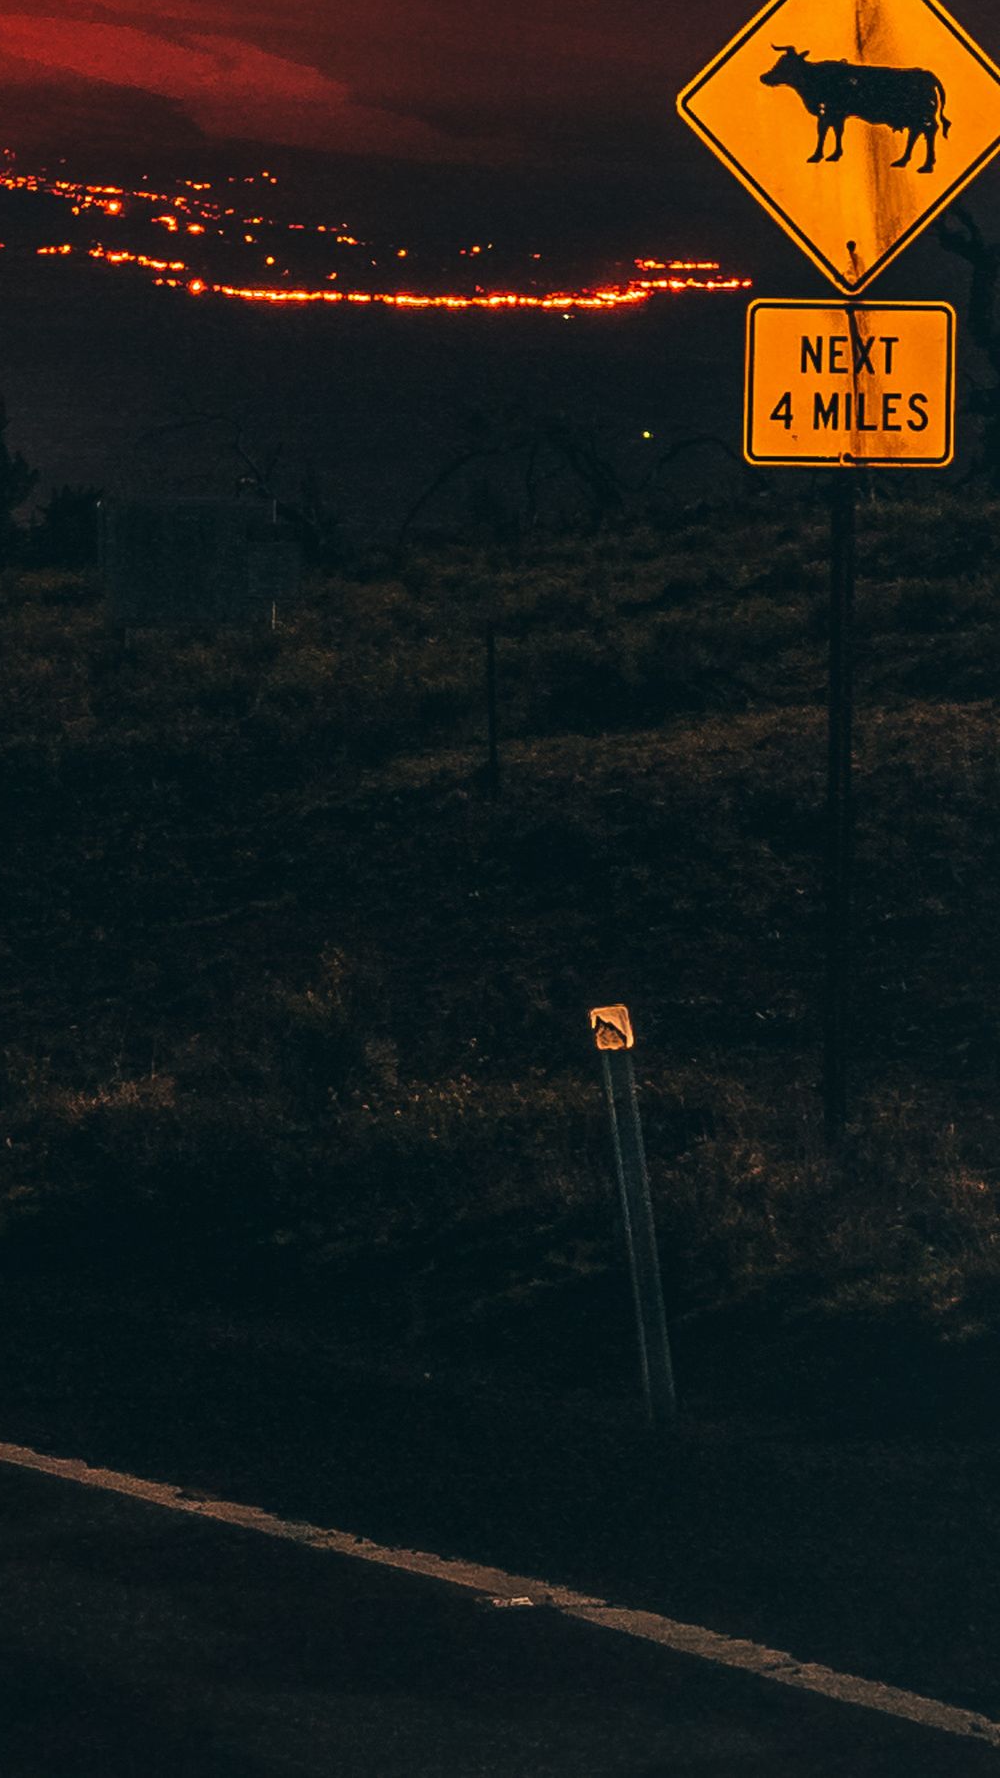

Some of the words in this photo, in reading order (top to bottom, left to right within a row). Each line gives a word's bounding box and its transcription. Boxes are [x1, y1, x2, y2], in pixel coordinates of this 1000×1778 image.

[801, 336, 899, 374] NEXT
[770, 391, 793, 430] 4
[813, 392, 929, 431] MILES
